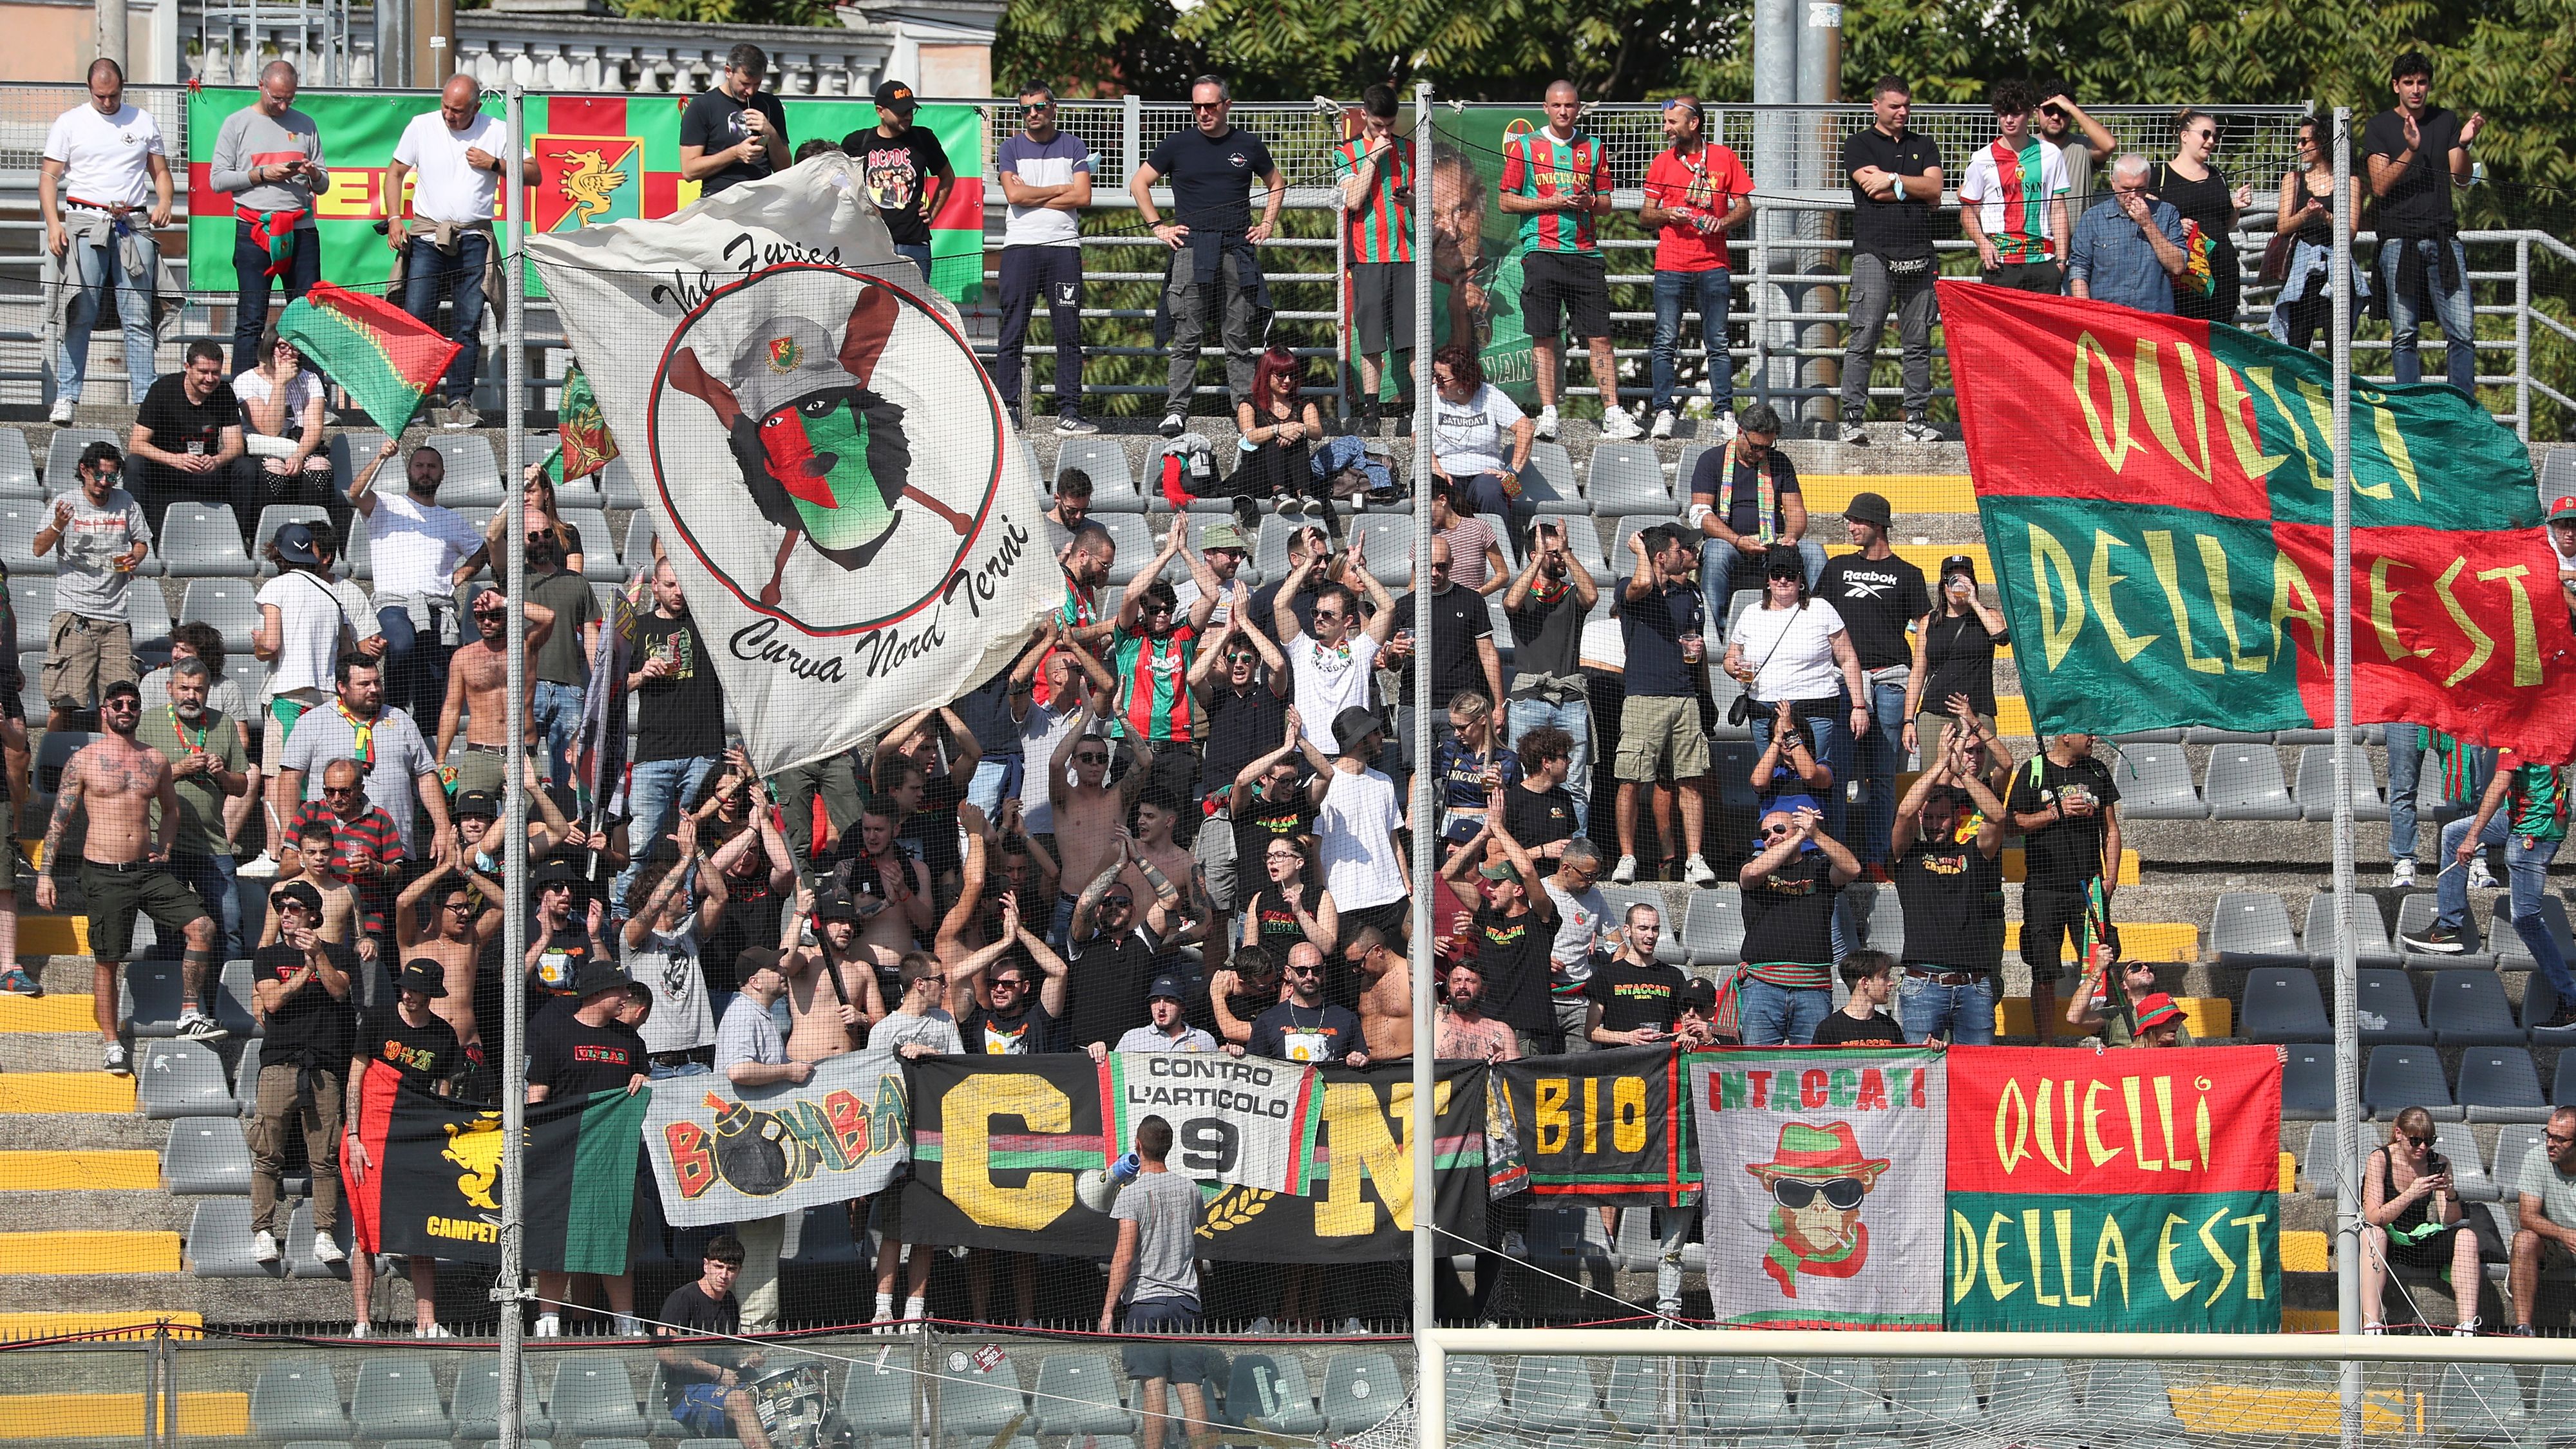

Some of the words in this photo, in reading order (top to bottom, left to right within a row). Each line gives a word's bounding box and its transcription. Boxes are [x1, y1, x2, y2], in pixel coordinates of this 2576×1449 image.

[868, 147, 911, 168] AC/DC
[651, 268, 715, 319] The
[723, 232, 844, 286] Furies
[1442, 416, 1485, 427] SATURDAY
[1842, 570, 1898, 585] Reebok
[2027, 522, 2328, 678] DELLA
[2369, 555, 2544, 689] EST
[729, 618, 848, 683] Curva
[855, 604, 945, 677] Nord
[1614, 983, 1671, 998] INTACCATI
[579, 1049, 625, 1062] ULTRAS
[1149, 1057, 1273, 1086] CONTRO
[1128, 1085, 1289, 1119] L'ARTICOLO
[1708, 1067, 1926, 1112] INTACCATI
[1502, 1076, 1647, 1155] BIO
[1180, 1117, 1239, 1173] 9
[1953, 1208, 2129, 1312] DELLA
[2157, 1207, 2267, 1309] EST
[981, 1350, 998, 1364] 1905
